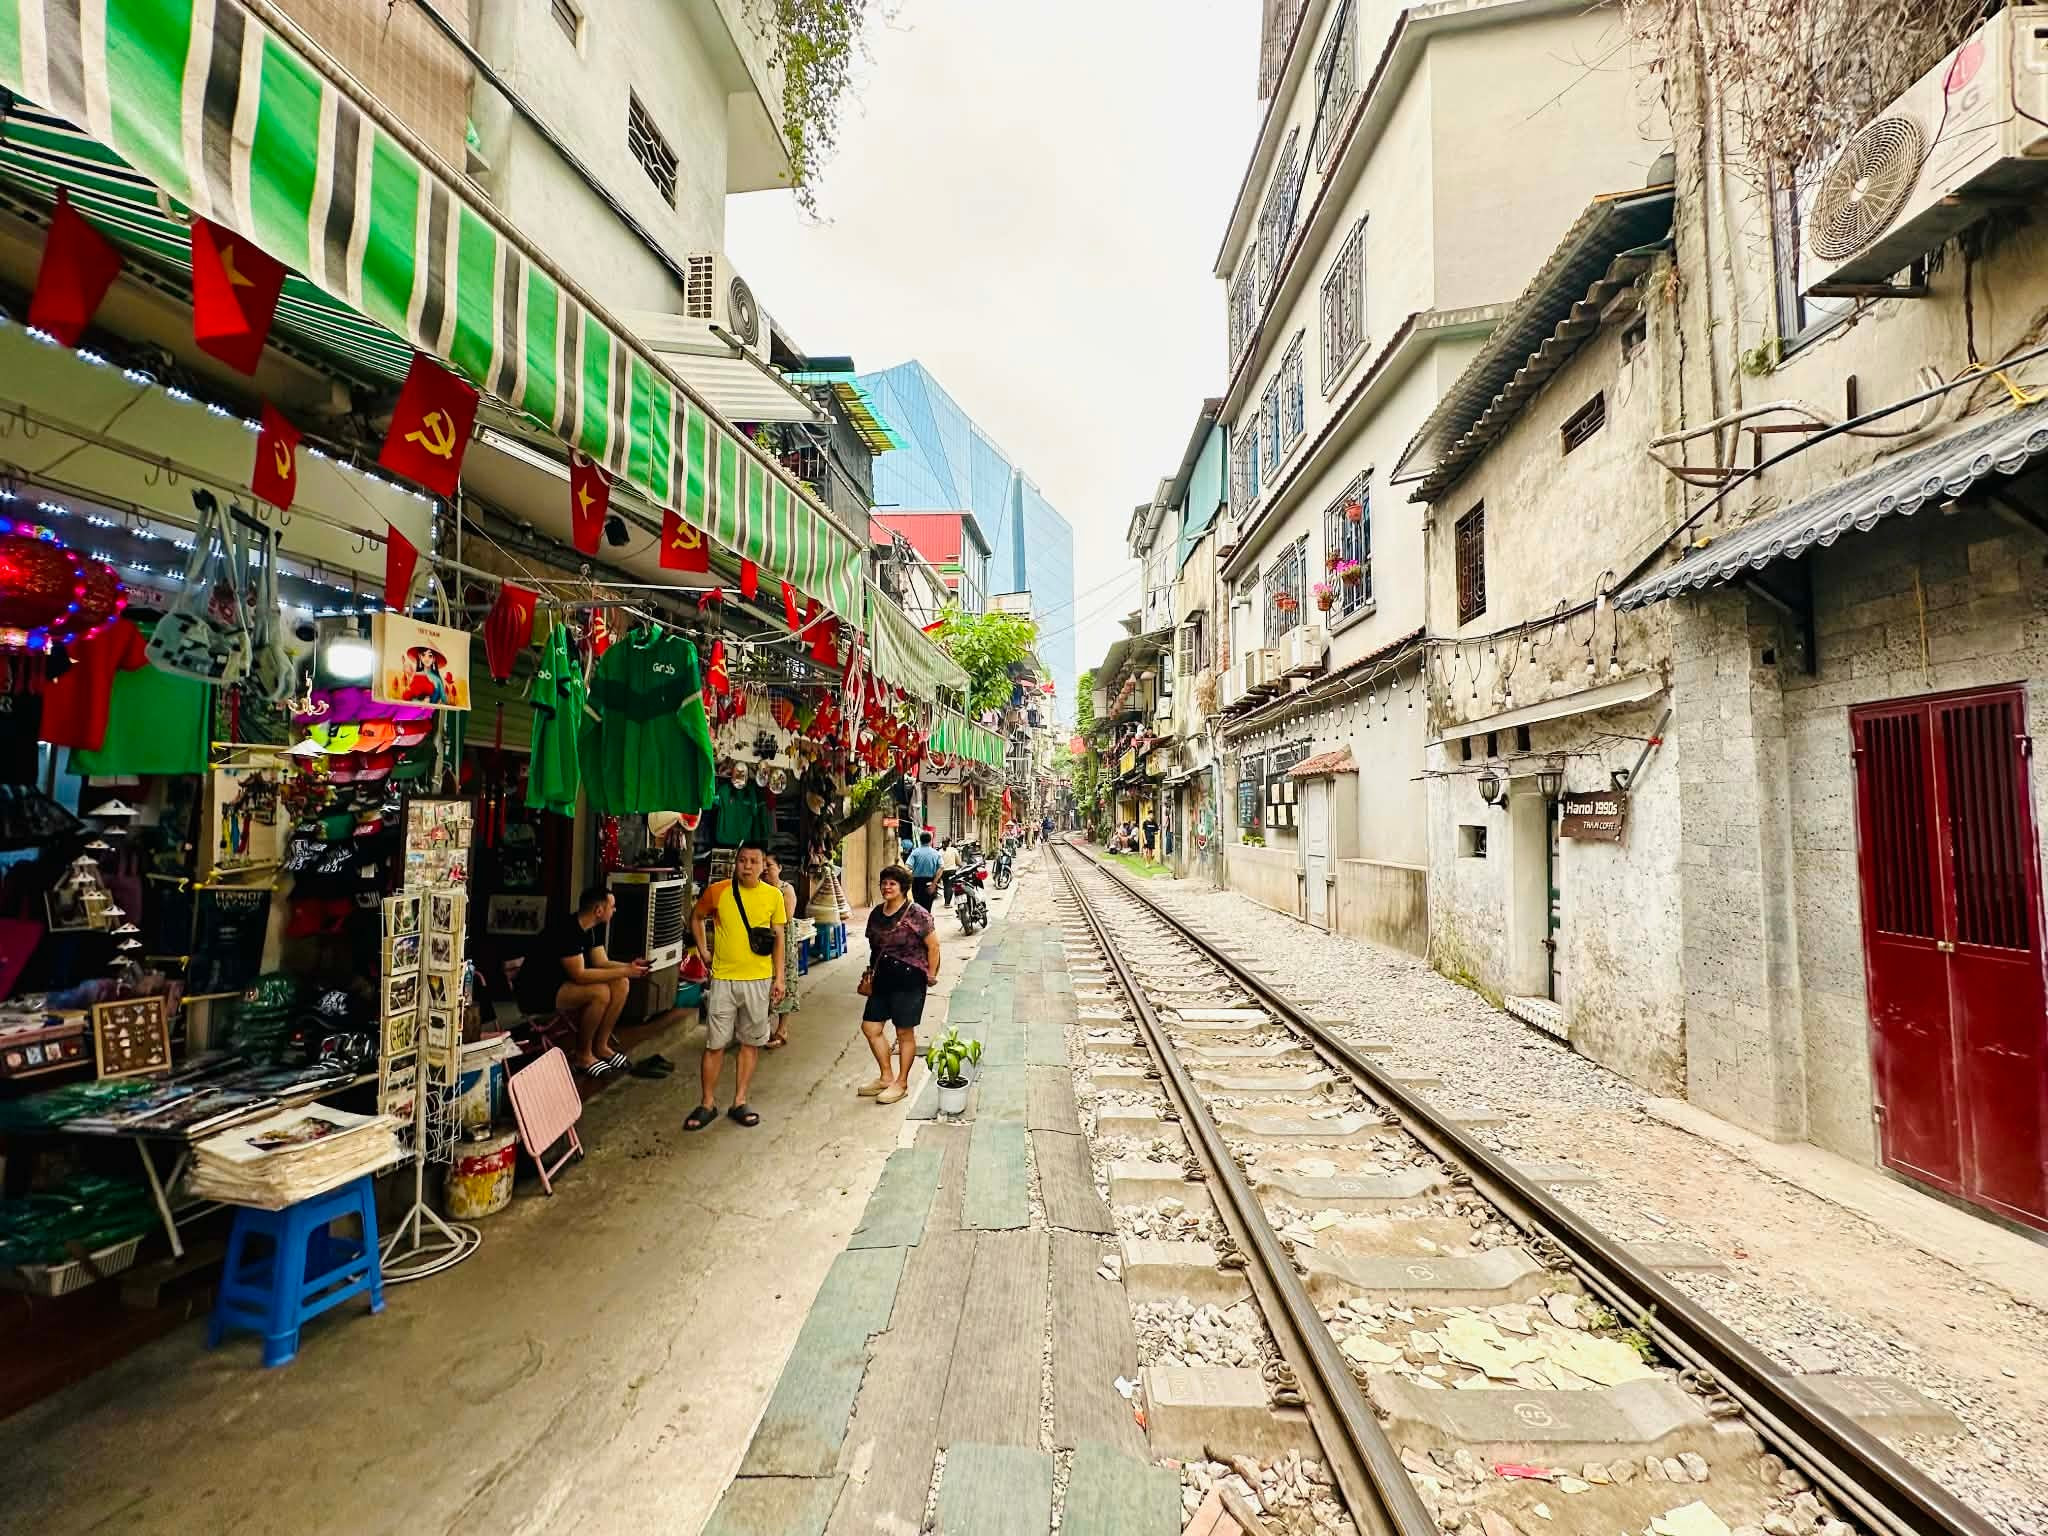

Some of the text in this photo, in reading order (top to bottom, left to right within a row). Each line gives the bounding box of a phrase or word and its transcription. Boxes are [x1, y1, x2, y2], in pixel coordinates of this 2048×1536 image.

[537, 670, 552, 680] ab
[652, 662, 676, 675] Grab
[1566, 801, 1618, 815] Hanoi 1990s
